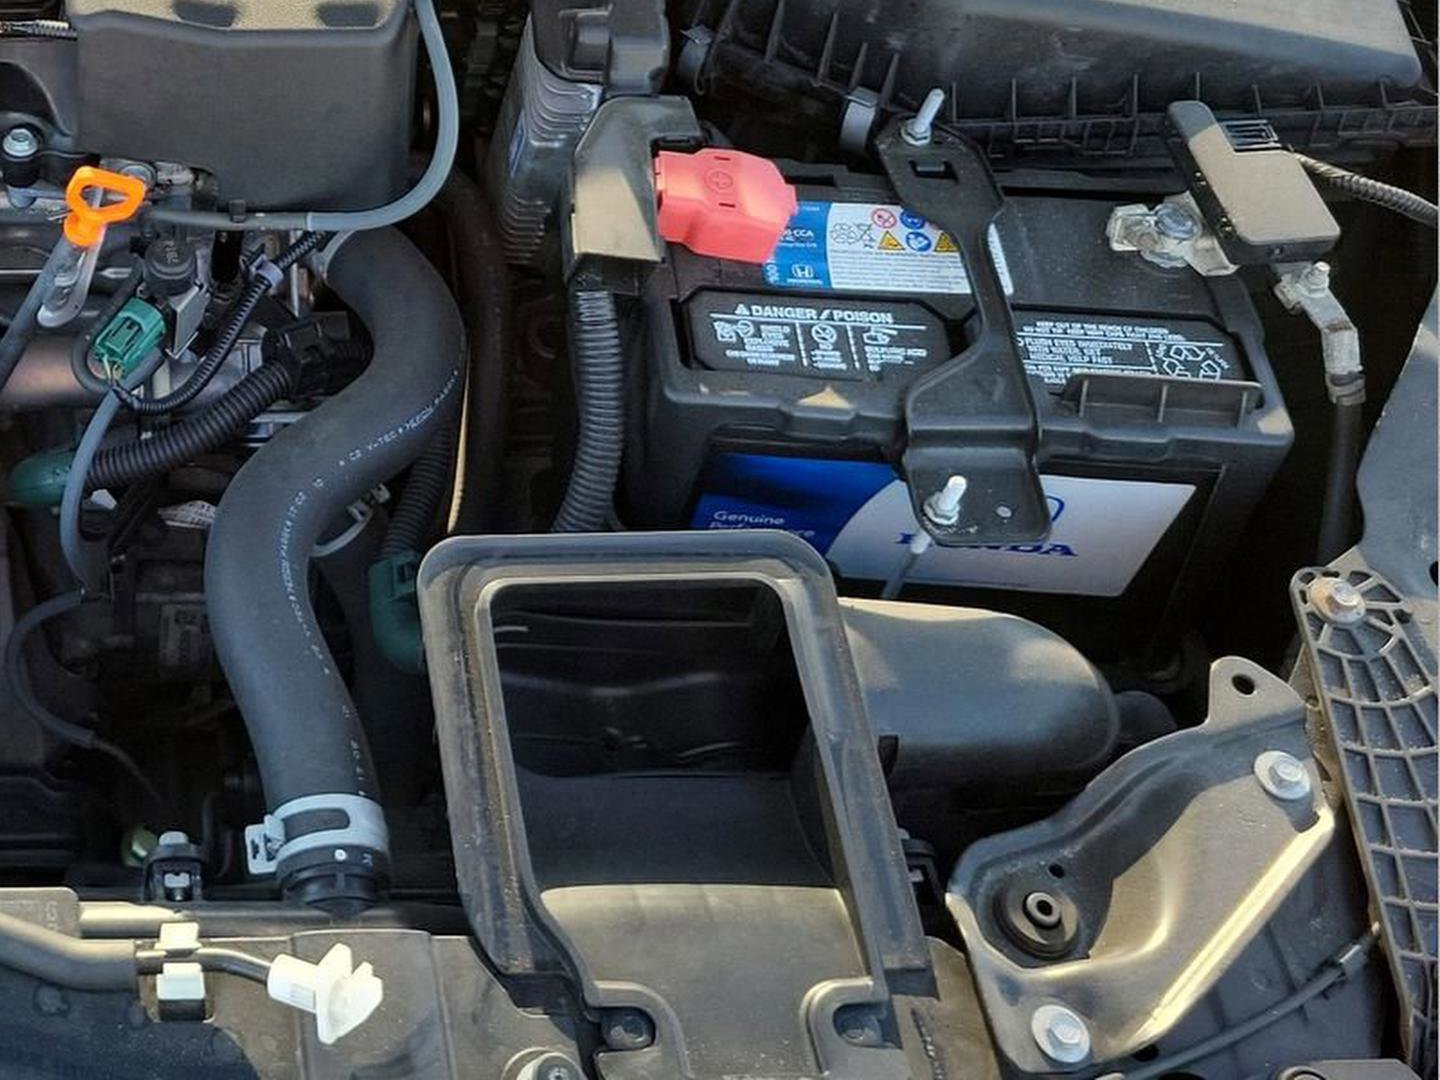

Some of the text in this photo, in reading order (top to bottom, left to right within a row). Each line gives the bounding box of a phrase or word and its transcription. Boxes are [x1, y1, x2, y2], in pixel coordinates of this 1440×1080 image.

[750, 305, 818, 320] DANGER
[832, 309, 894, 325] POISON
[713, 510, 785, 525] Genuine
